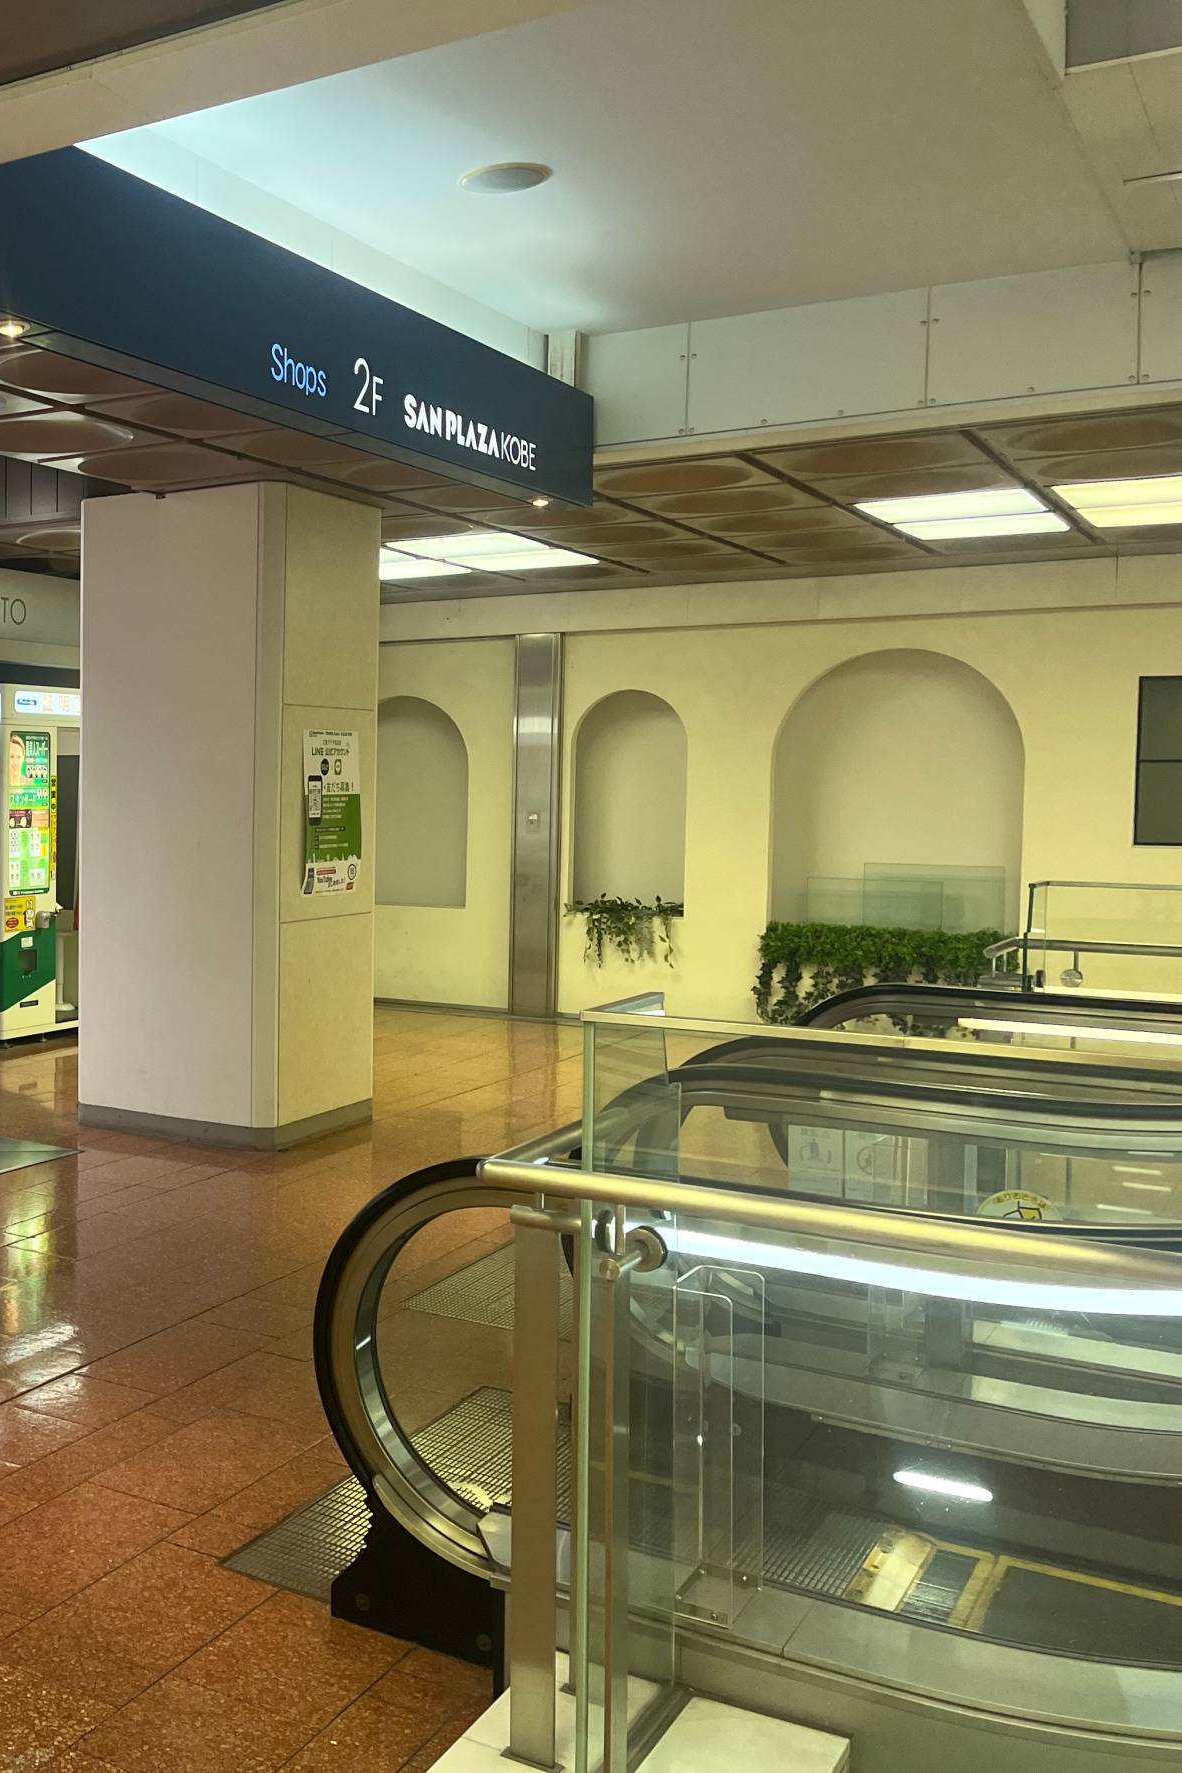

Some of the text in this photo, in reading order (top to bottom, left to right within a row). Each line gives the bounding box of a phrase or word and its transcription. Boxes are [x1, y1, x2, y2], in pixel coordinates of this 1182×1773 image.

[271, 343, 327, 397] Shops
[353, 358, 384, 416] 2F
[404, 394, 537, 472] SAN PLAZA KOBE
[311, 748, 324, 756] LINE
